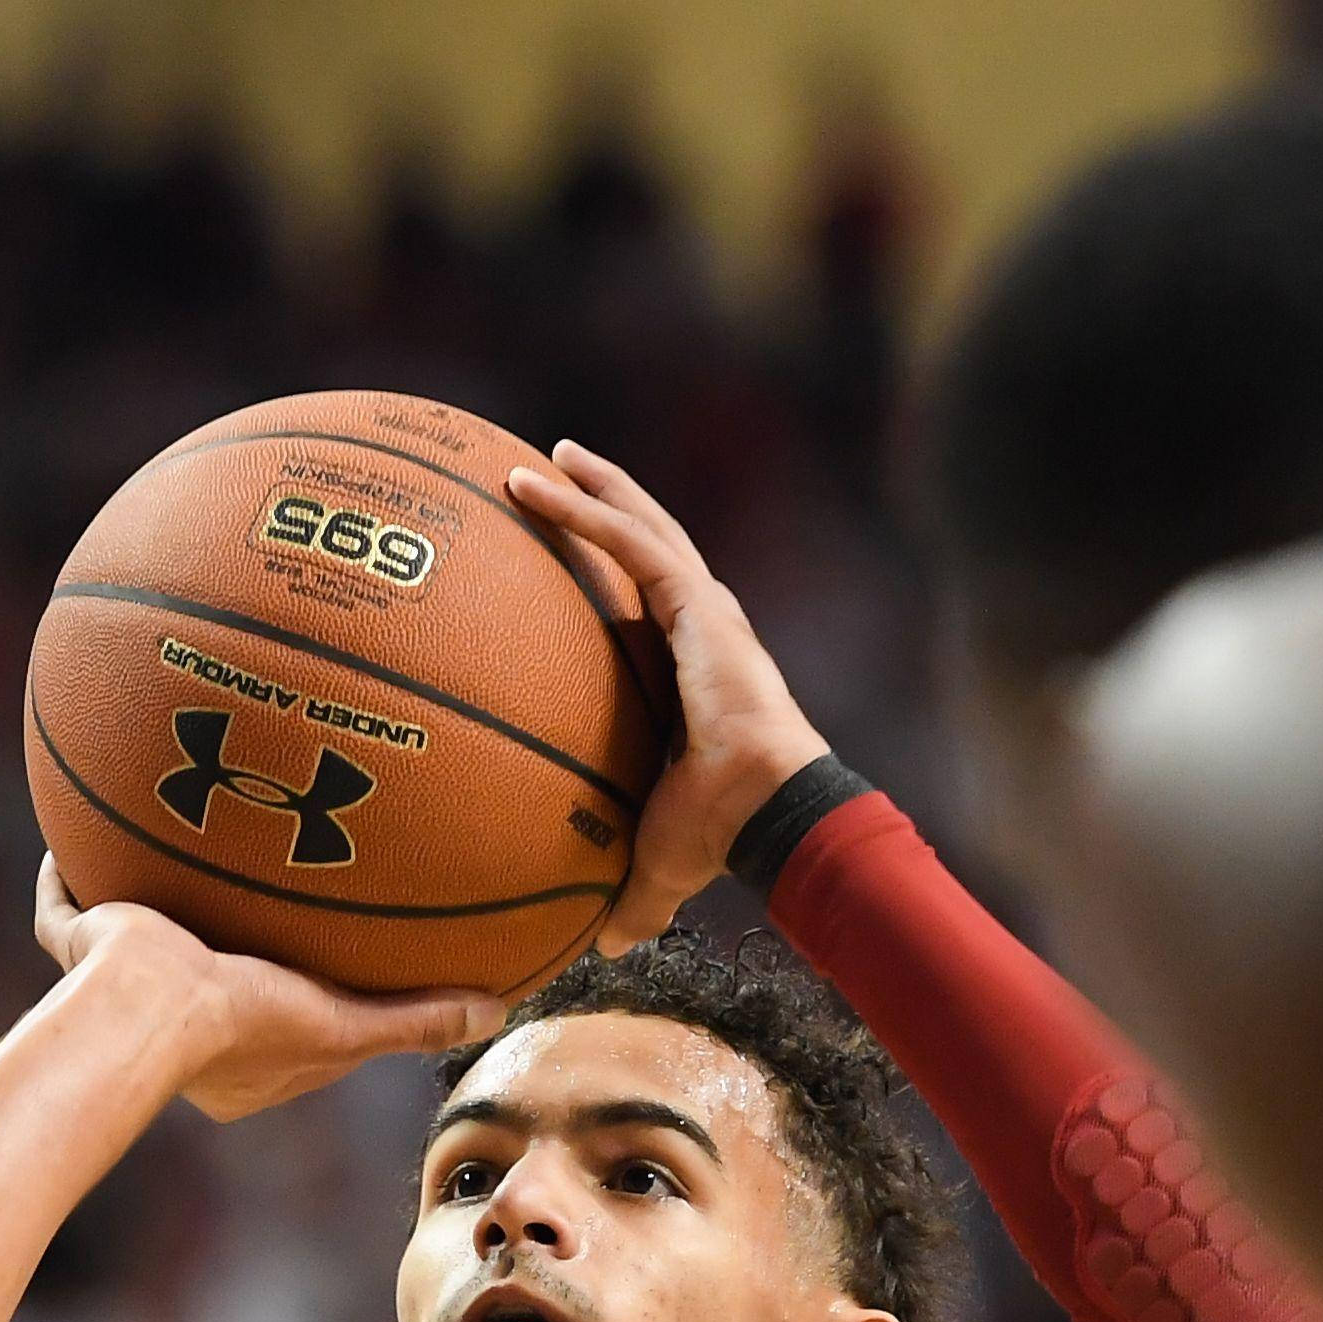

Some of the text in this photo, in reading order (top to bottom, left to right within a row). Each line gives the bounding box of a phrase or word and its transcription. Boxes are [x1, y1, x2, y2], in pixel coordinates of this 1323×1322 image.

[261, 496, 435, 586] 695
[161, 637, 427, 750] UNDER ARMOUR
